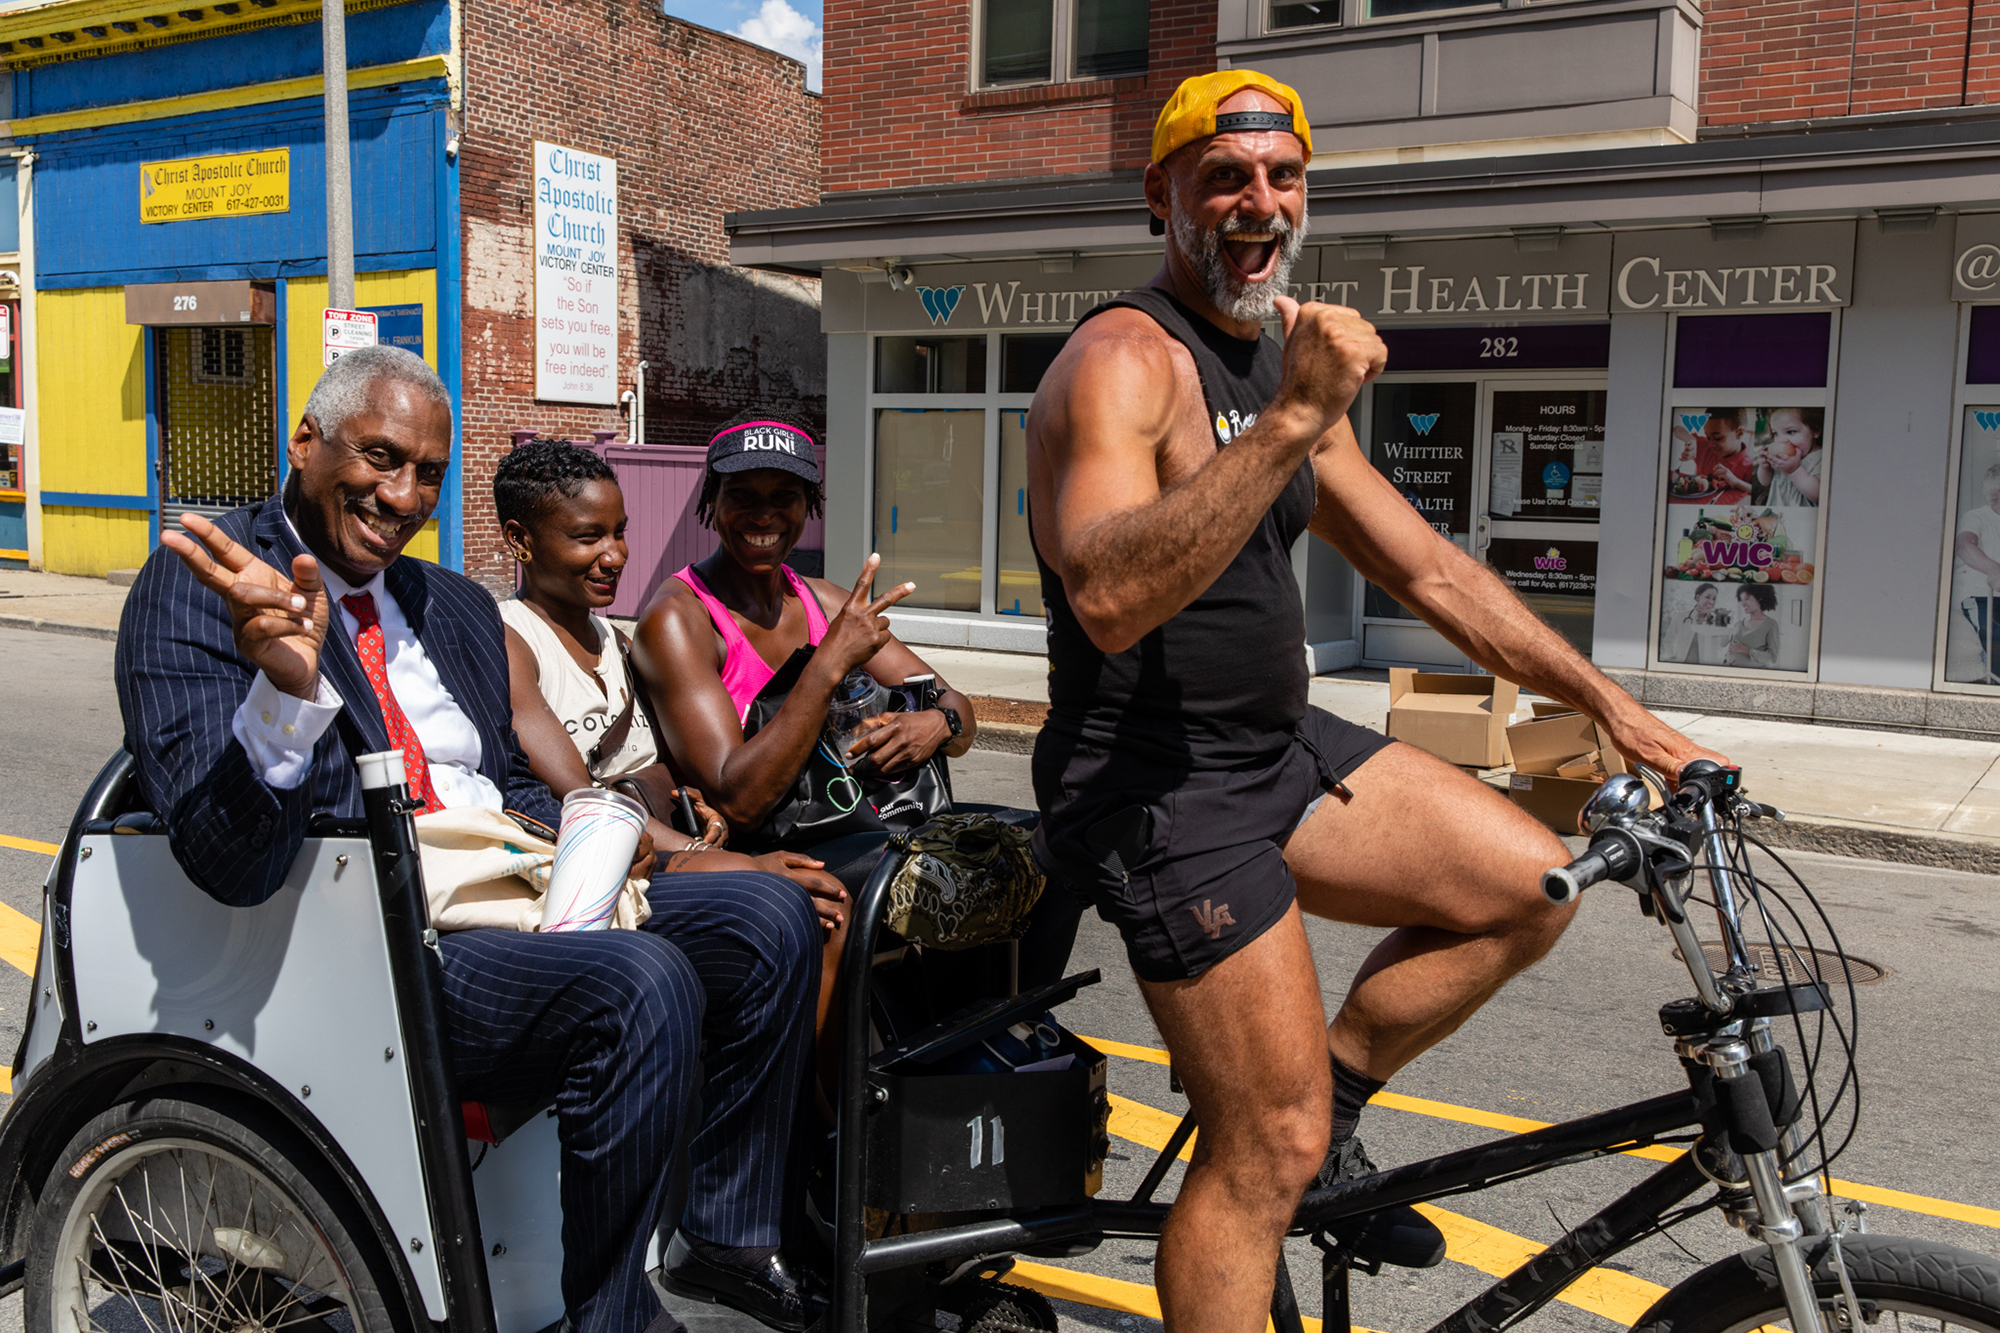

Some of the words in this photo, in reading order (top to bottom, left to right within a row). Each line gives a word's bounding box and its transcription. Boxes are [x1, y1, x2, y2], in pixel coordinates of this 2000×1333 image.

[155, 167, 189, 187] Christ
[192, 160, 243, 184] Apostolic
[246, 155, 286, 178] Church
[549, 148, 602, 182] Christ
[186, 185, 227, 200] MOUNT
[230, 183, 253, 198] JOY
[538, 177, 613, 216] Apostolic
[146, 204, 178, 218] VICTORY
[182, 201, 214, 215] CENTER
[226, 195, 284, 211] 617-427-0031
[547, 212, 605, 249] Church
[547, 243, 582, 260] MOUNT
[588, 250, 606, 264] JOY
[539, 254, 577, 272] VICTORY
[581, 262, 615, 278] CENTER
[585, 279, 593, 293] if
[972, 281, 1133, 324] WHITT
[1378, 265, 1589, 315] HEALTH
[1617, 256, 1842, 309] CENTER
[174, 295, 197, 311] 276
[557, 296, 575, 311] the
[578, 298, 599, 314] Son
[327, 312, 348, 320] TOW
[350, 314, 374, 323] ZONE
[344, 322, 366, 330] STREET
[344, 329, 372, 337] CLEANING
[541, 316, 565, 330] sets
[568, 320, 588, 335] you
[590, 320, 614, 338] free,
[550, 342, 570, 357] you
[573, 342, 590, 357] will
[593, 343, 606, 359] be
[1479, 336, 1519, 359] 282
[545, 358, 567, 375] free
[562, 381, 579, 391] John
[580, 382, 594, 392] 8:36
[1540, 405, 1576, 415] HOURS
[744, 427, 771, 437] BLACK
[773, 428, 795, 440] GIRLS
[1505, 425, 1533, 433] Monday
[1538, 425, 1562, 433] Friday:
[744, 434, 797, 456] RUN!
[1528, 434, 1560, 442] Saturday:
[1384, 442, 1464, 459] WHITTIER
[1530, 443, 1558, 451] Sunday:
[1393, 466, 1452, 484] STREET
[1400, 493, 1454, 511] EALTH
[1546, 498, 1566, 506] Other
[1568, 498, 1584, 506] Door
[1702, 540, 1774, 567] WIC
[1534, 556, 1567, 570] WIC
[1506, 570, 1547, 580] Wednesday:
[1548, 572, 1574, 580] 8:30am
[1579, 574, 1595, 582] 5pm
[1541, 581, 1557, 590] App.
[966, 1115, 1004, 1169] 11
